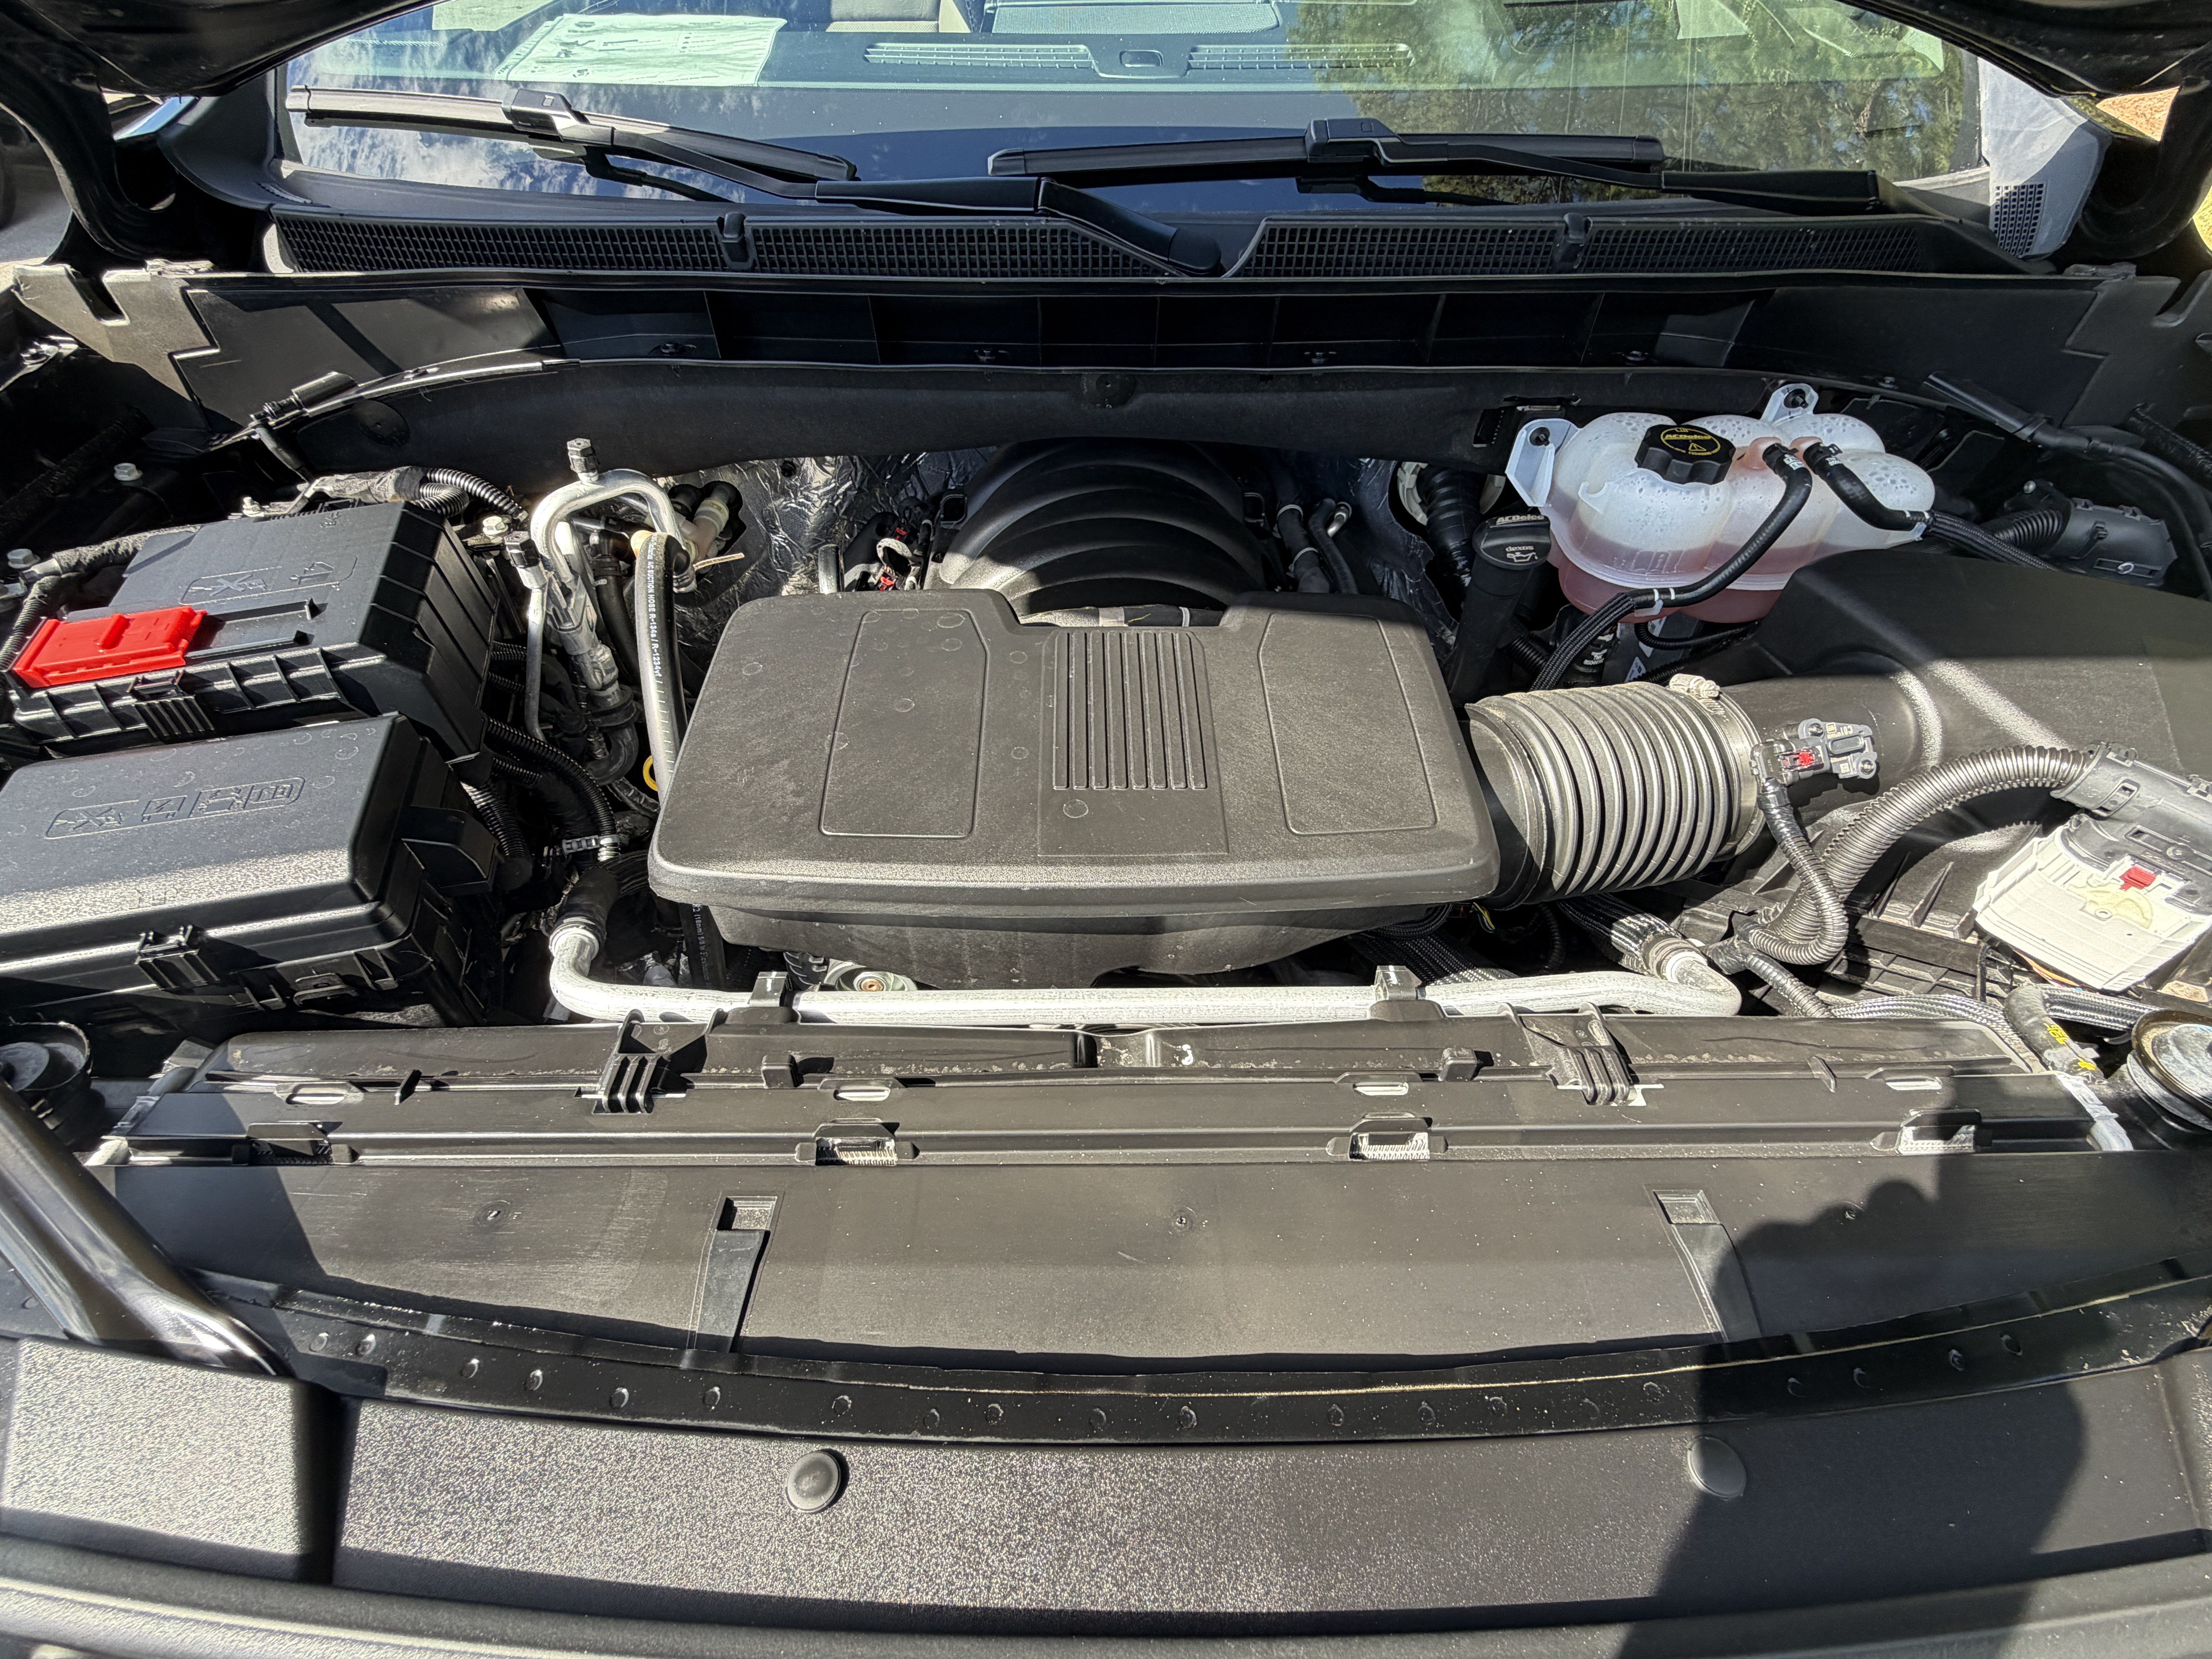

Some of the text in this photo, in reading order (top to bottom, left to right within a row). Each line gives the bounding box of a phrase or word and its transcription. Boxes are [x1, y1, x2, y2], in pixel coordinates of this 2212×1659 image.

[1496, 514, 1544, 525] ACDelco
[649, 613, 658, 638] R-134a
[651, 643, 662, 677] R-1234yf
[694, 914, 704, 936] (16mm)
